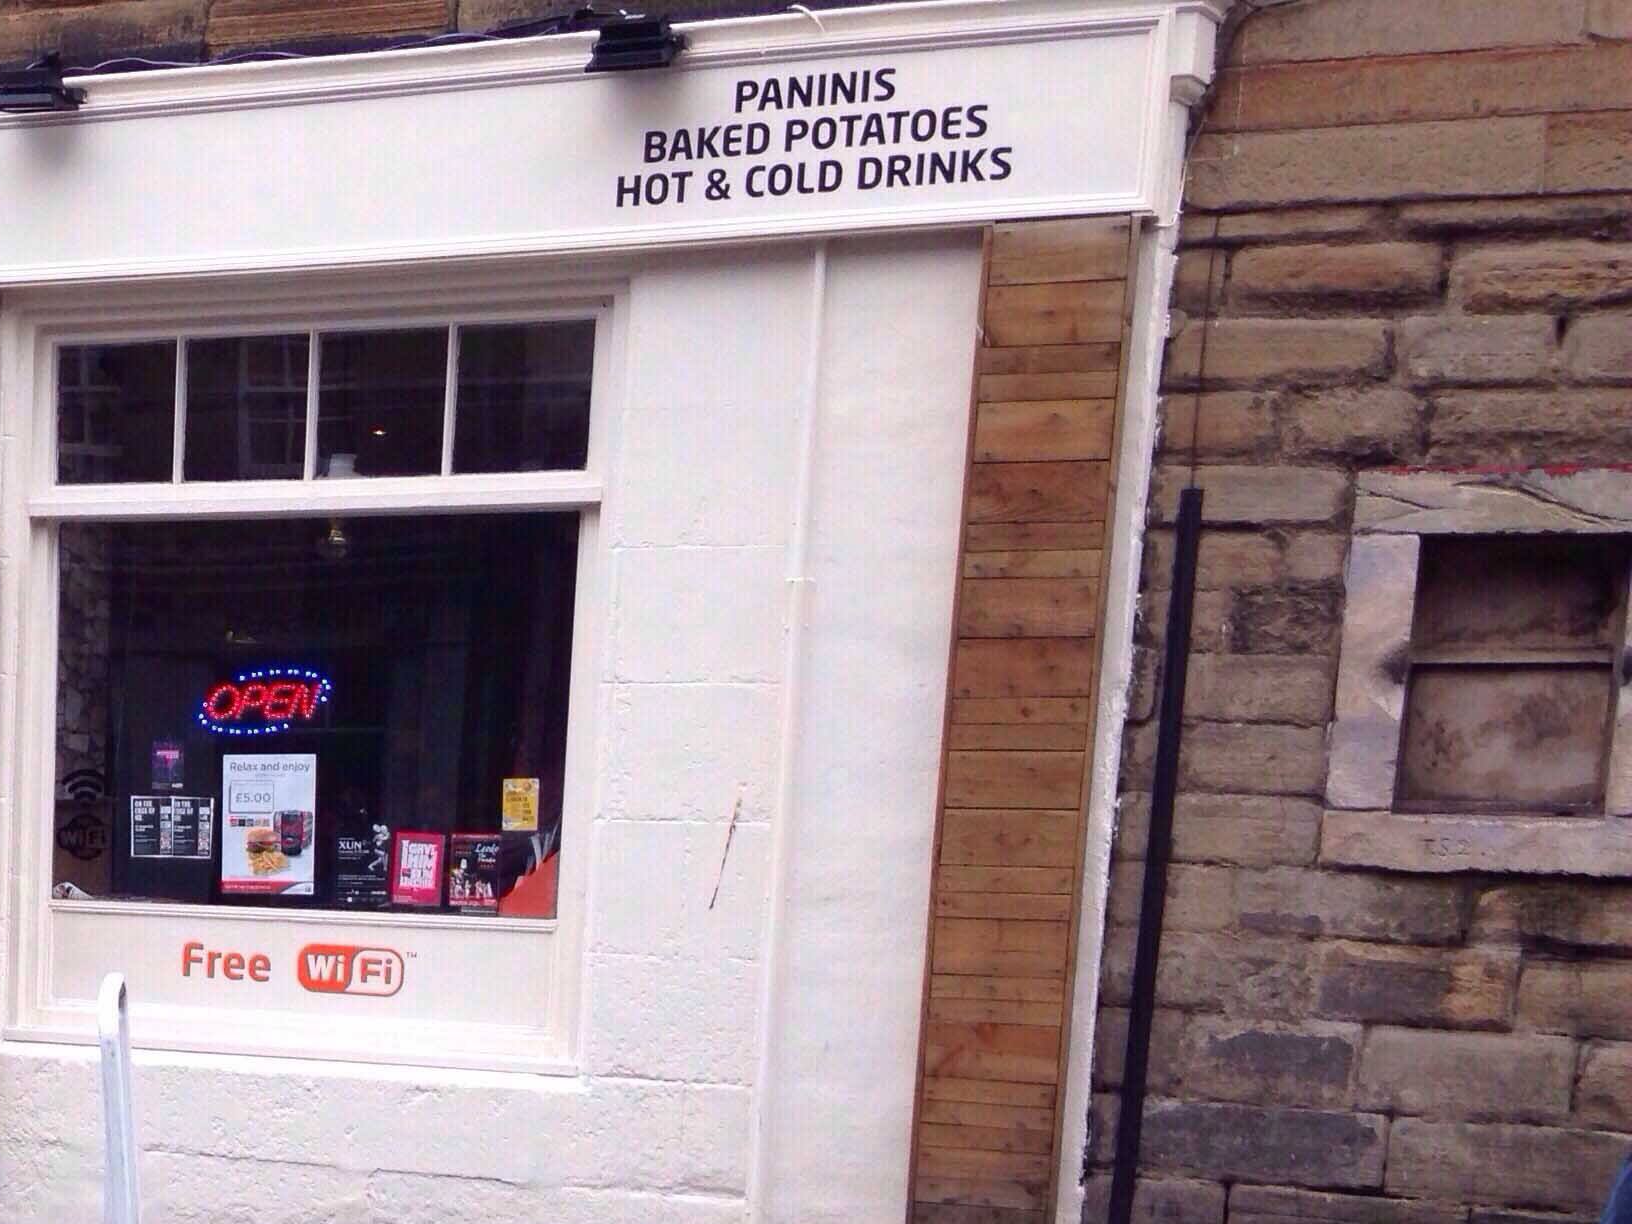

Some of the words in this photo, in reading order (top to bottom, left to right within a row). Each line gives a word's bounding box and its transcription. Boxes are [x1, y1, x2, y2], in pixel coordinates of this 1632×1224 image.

[734, 68, 896, 113] PANINIS
[643, 121, 770, 164] BAKED
[784, 104, 988, 153] POTATOES
[616, 170, 693, 208] HOT
[705, 168, 731, 201] &
[745, 158, 843, 198] COLD
[857, 147, 1013, 190] DRINKS
[207, 683, 323, 720] OPEN
[230, 761, 258, 772] Relax
[260, 761, 280, 772] and
[282, 761, 311, 773] enjoy
[235, 792, 272, 804] £5.00
[338, 840, 362, 850] XUN
[181, 942, 272, 983] Free
